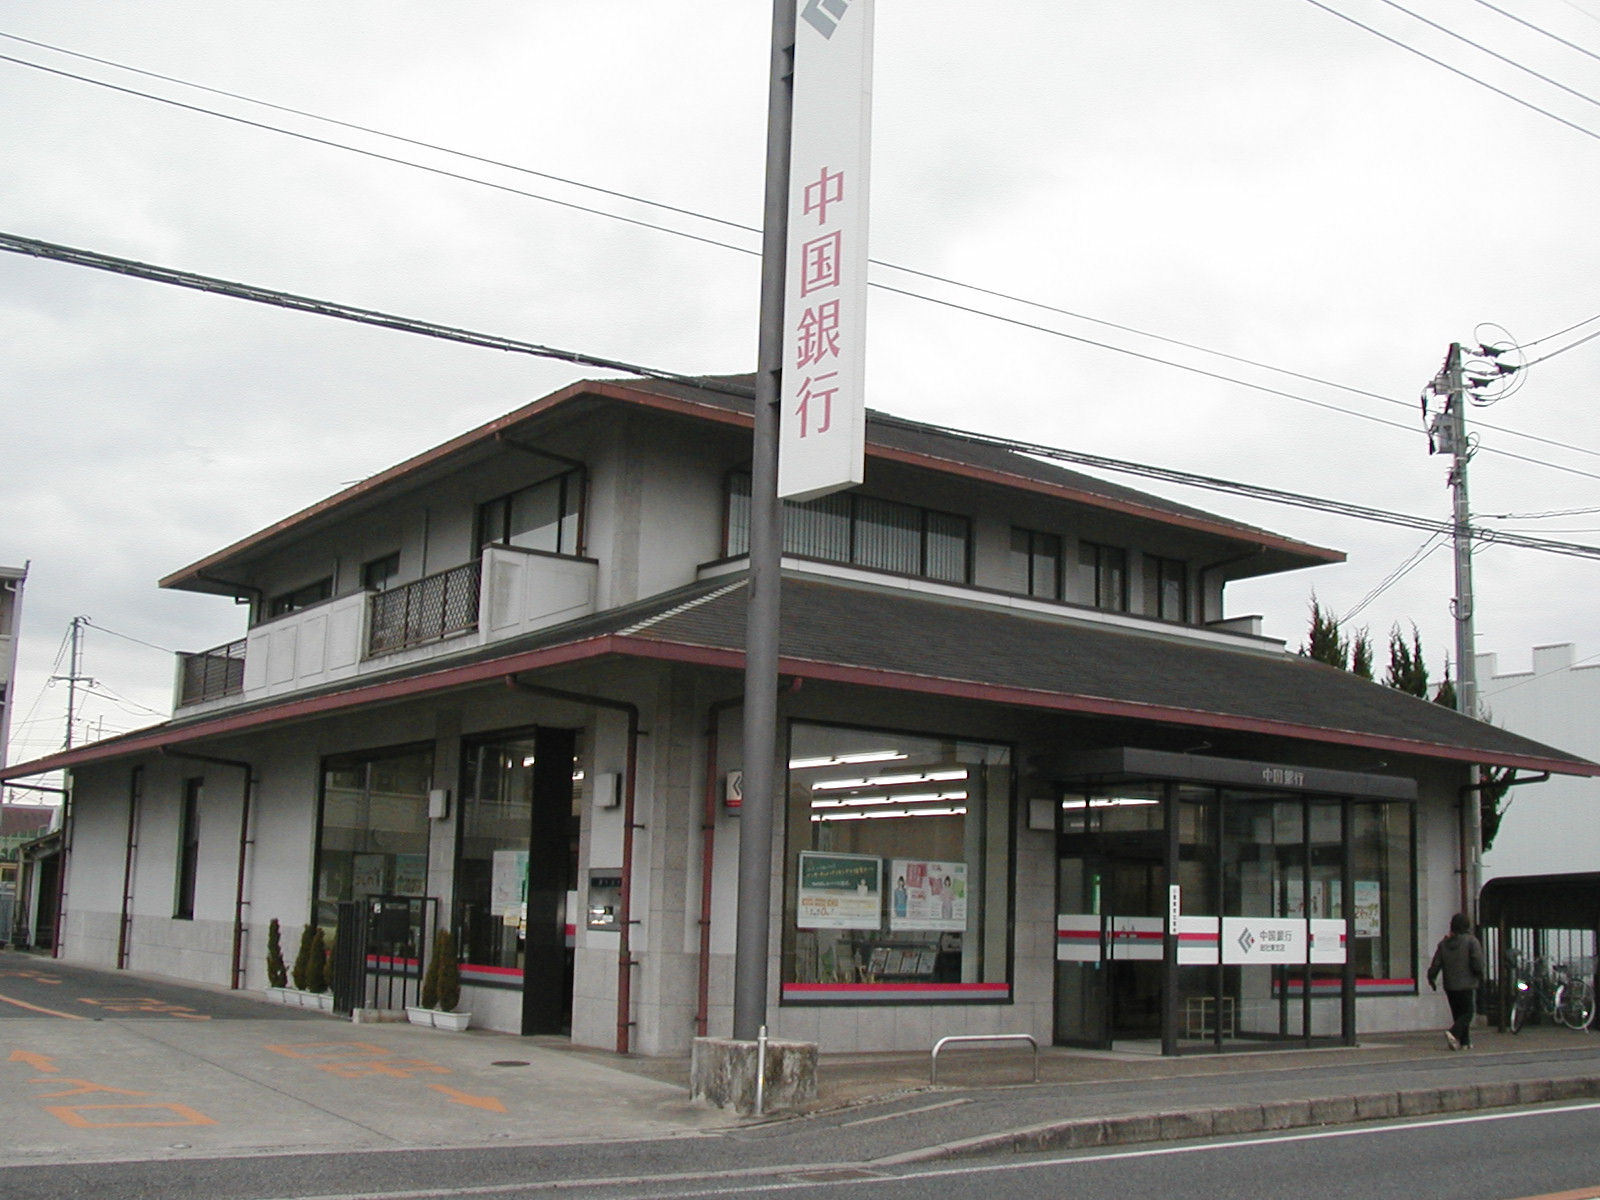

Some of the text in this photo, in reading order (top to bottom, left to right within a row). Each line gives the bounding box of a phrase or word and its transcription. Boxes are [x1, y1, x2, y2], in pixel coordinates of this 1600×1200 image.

[795, 166, 844, 438] 中国銀行
[1263, 769, 1304, 786] 中国銀行
[1259, 930, 1292, 942] 中国銀行
[27, 1078, 219, 1128] 入口
